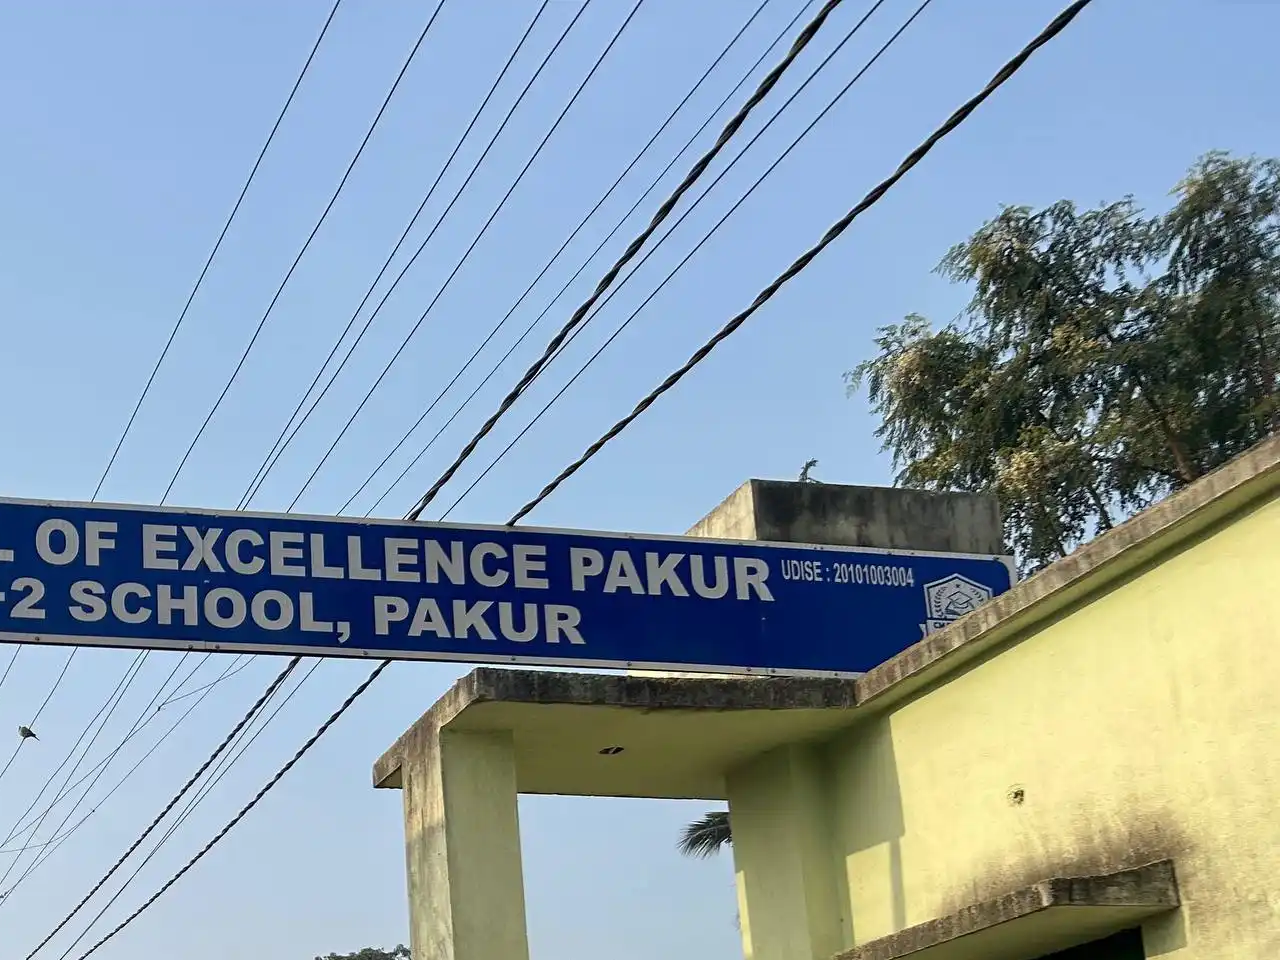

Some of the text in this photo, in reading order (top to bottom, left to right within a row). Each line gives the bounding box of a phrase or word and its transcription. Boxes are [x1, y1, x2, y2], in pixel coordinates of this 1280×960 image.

[35, 518, 118, 567] OF
[142, 524, 549, 589] EXCELLENCE
[569, 547, 775, 602] PAKUR
[781, 559, 823, 582] UDISE
[833, 562, 914, 588] 20101003004
[68, 580, 351, 642] SCHOOL,
[373, 595, 586, 645] PAKUR
